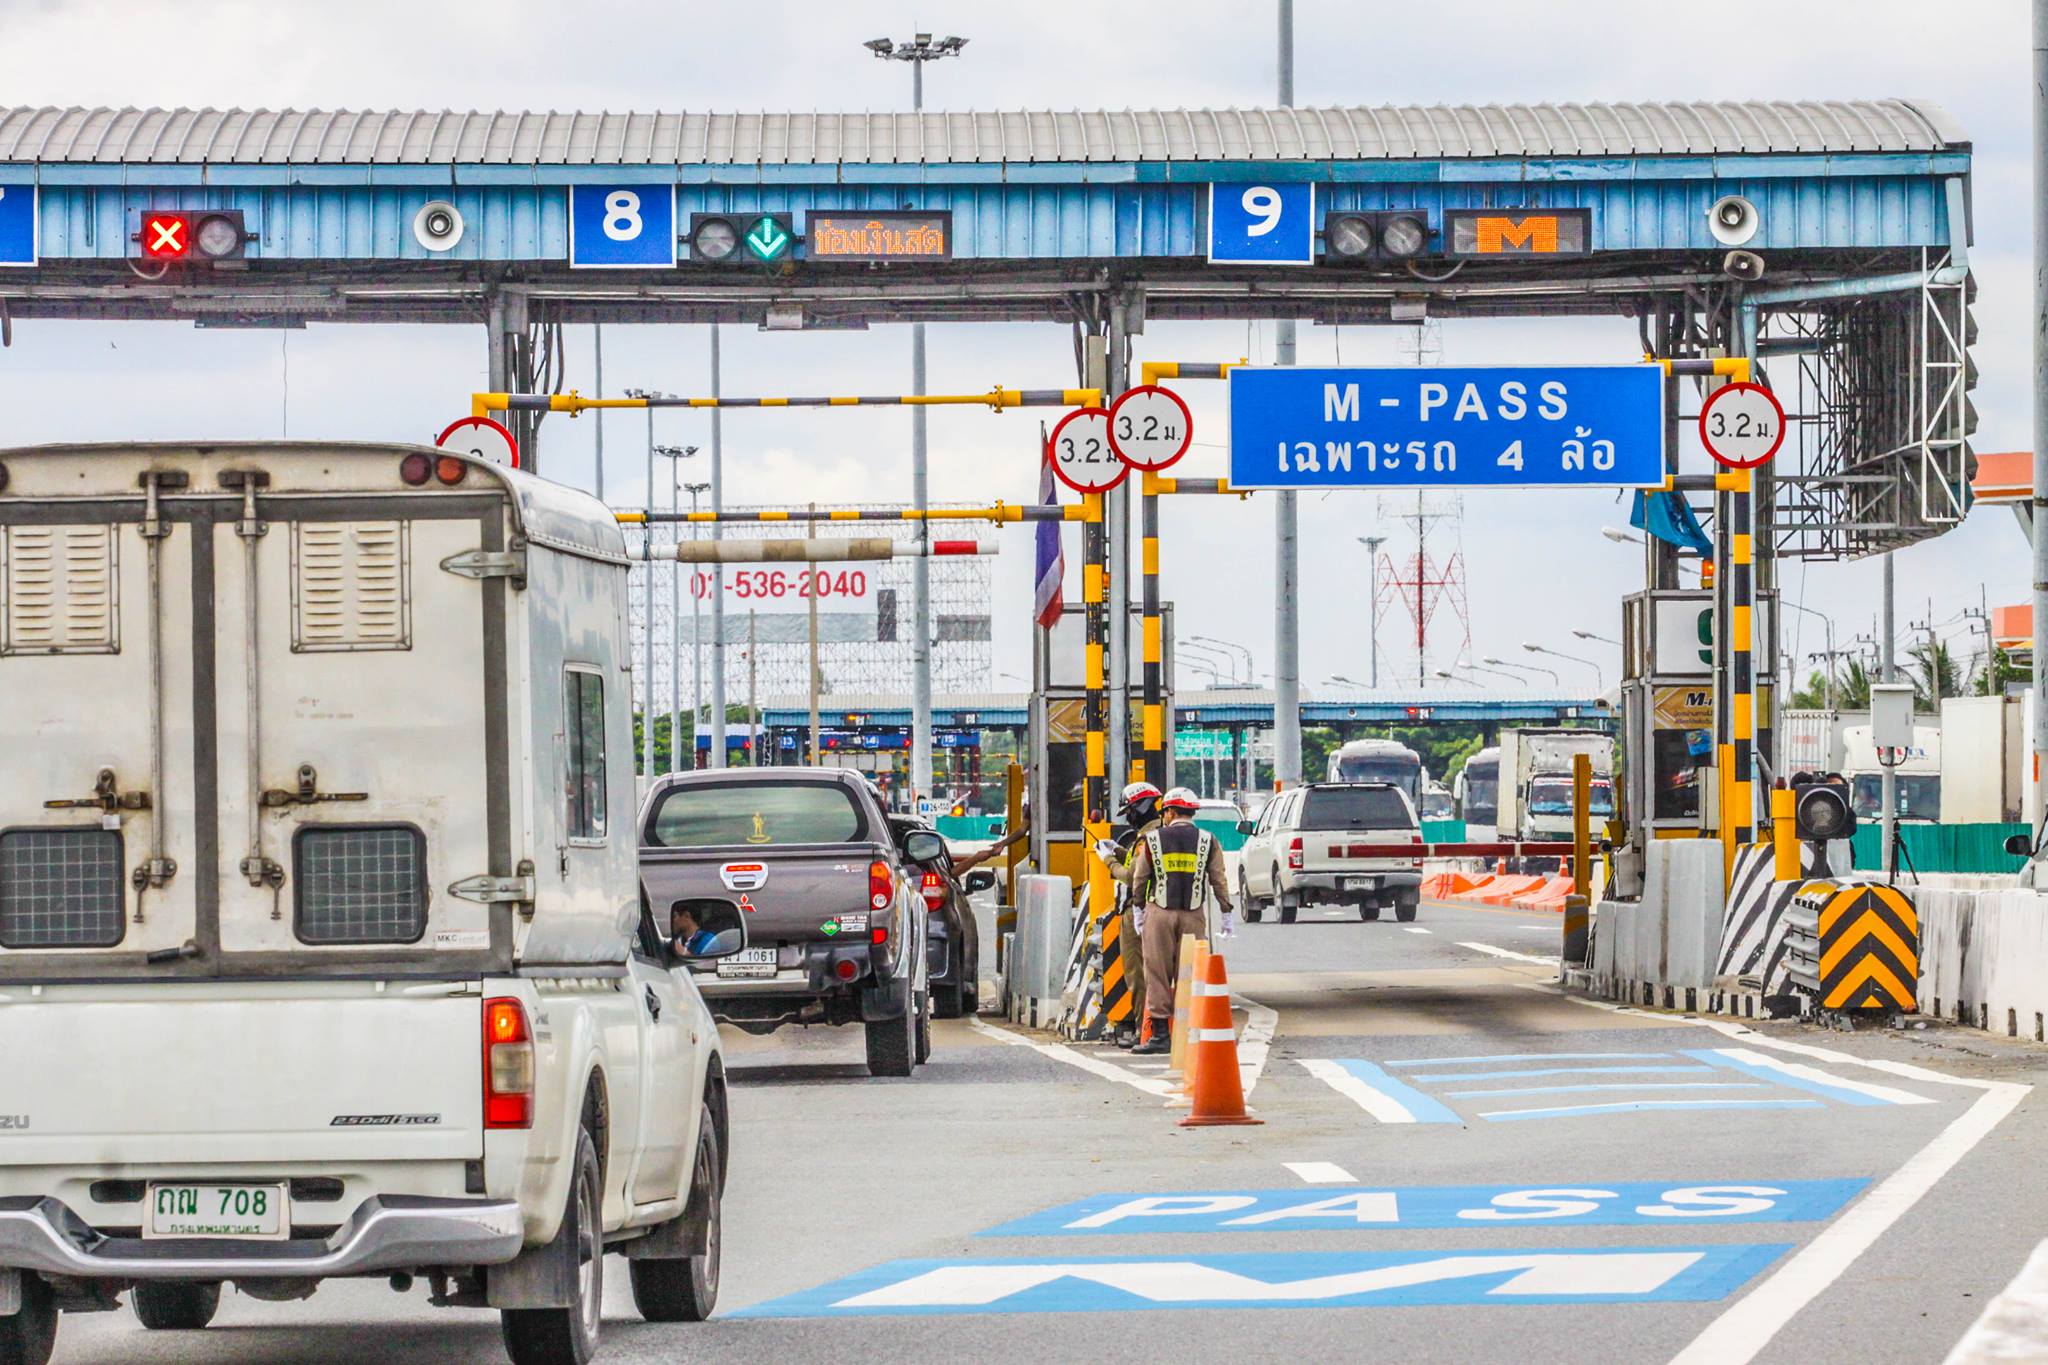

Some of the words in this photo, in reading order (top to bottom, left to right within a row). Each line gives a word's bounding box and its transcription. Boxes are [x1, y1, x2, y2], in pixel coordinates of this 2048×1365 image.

[602, 189, 643, 241] 8
[1241, 186, 1282, 237] 9
[814, 218, 944, 255] ช่องเงินสด
[1476, 216, 1557, 253] M
[1420, 381, 1568, 421] PASS
[1278, 440, 1457, 473] เฉพาะรถ
[1497, 440, 1525, 471] 4
[1561, 426, 1616, 471] ล้อ
[1149, 836, 1165, 895] MOTORWAY
[1194, 838, 1208, 899] MOTORWAY
[748, 951, 774, 962] 1061
[218, 1189, 267, 1216] 708
[1062, 1186, 1788, 1228] PASS
[828, 1254, 1705, 1308] M
